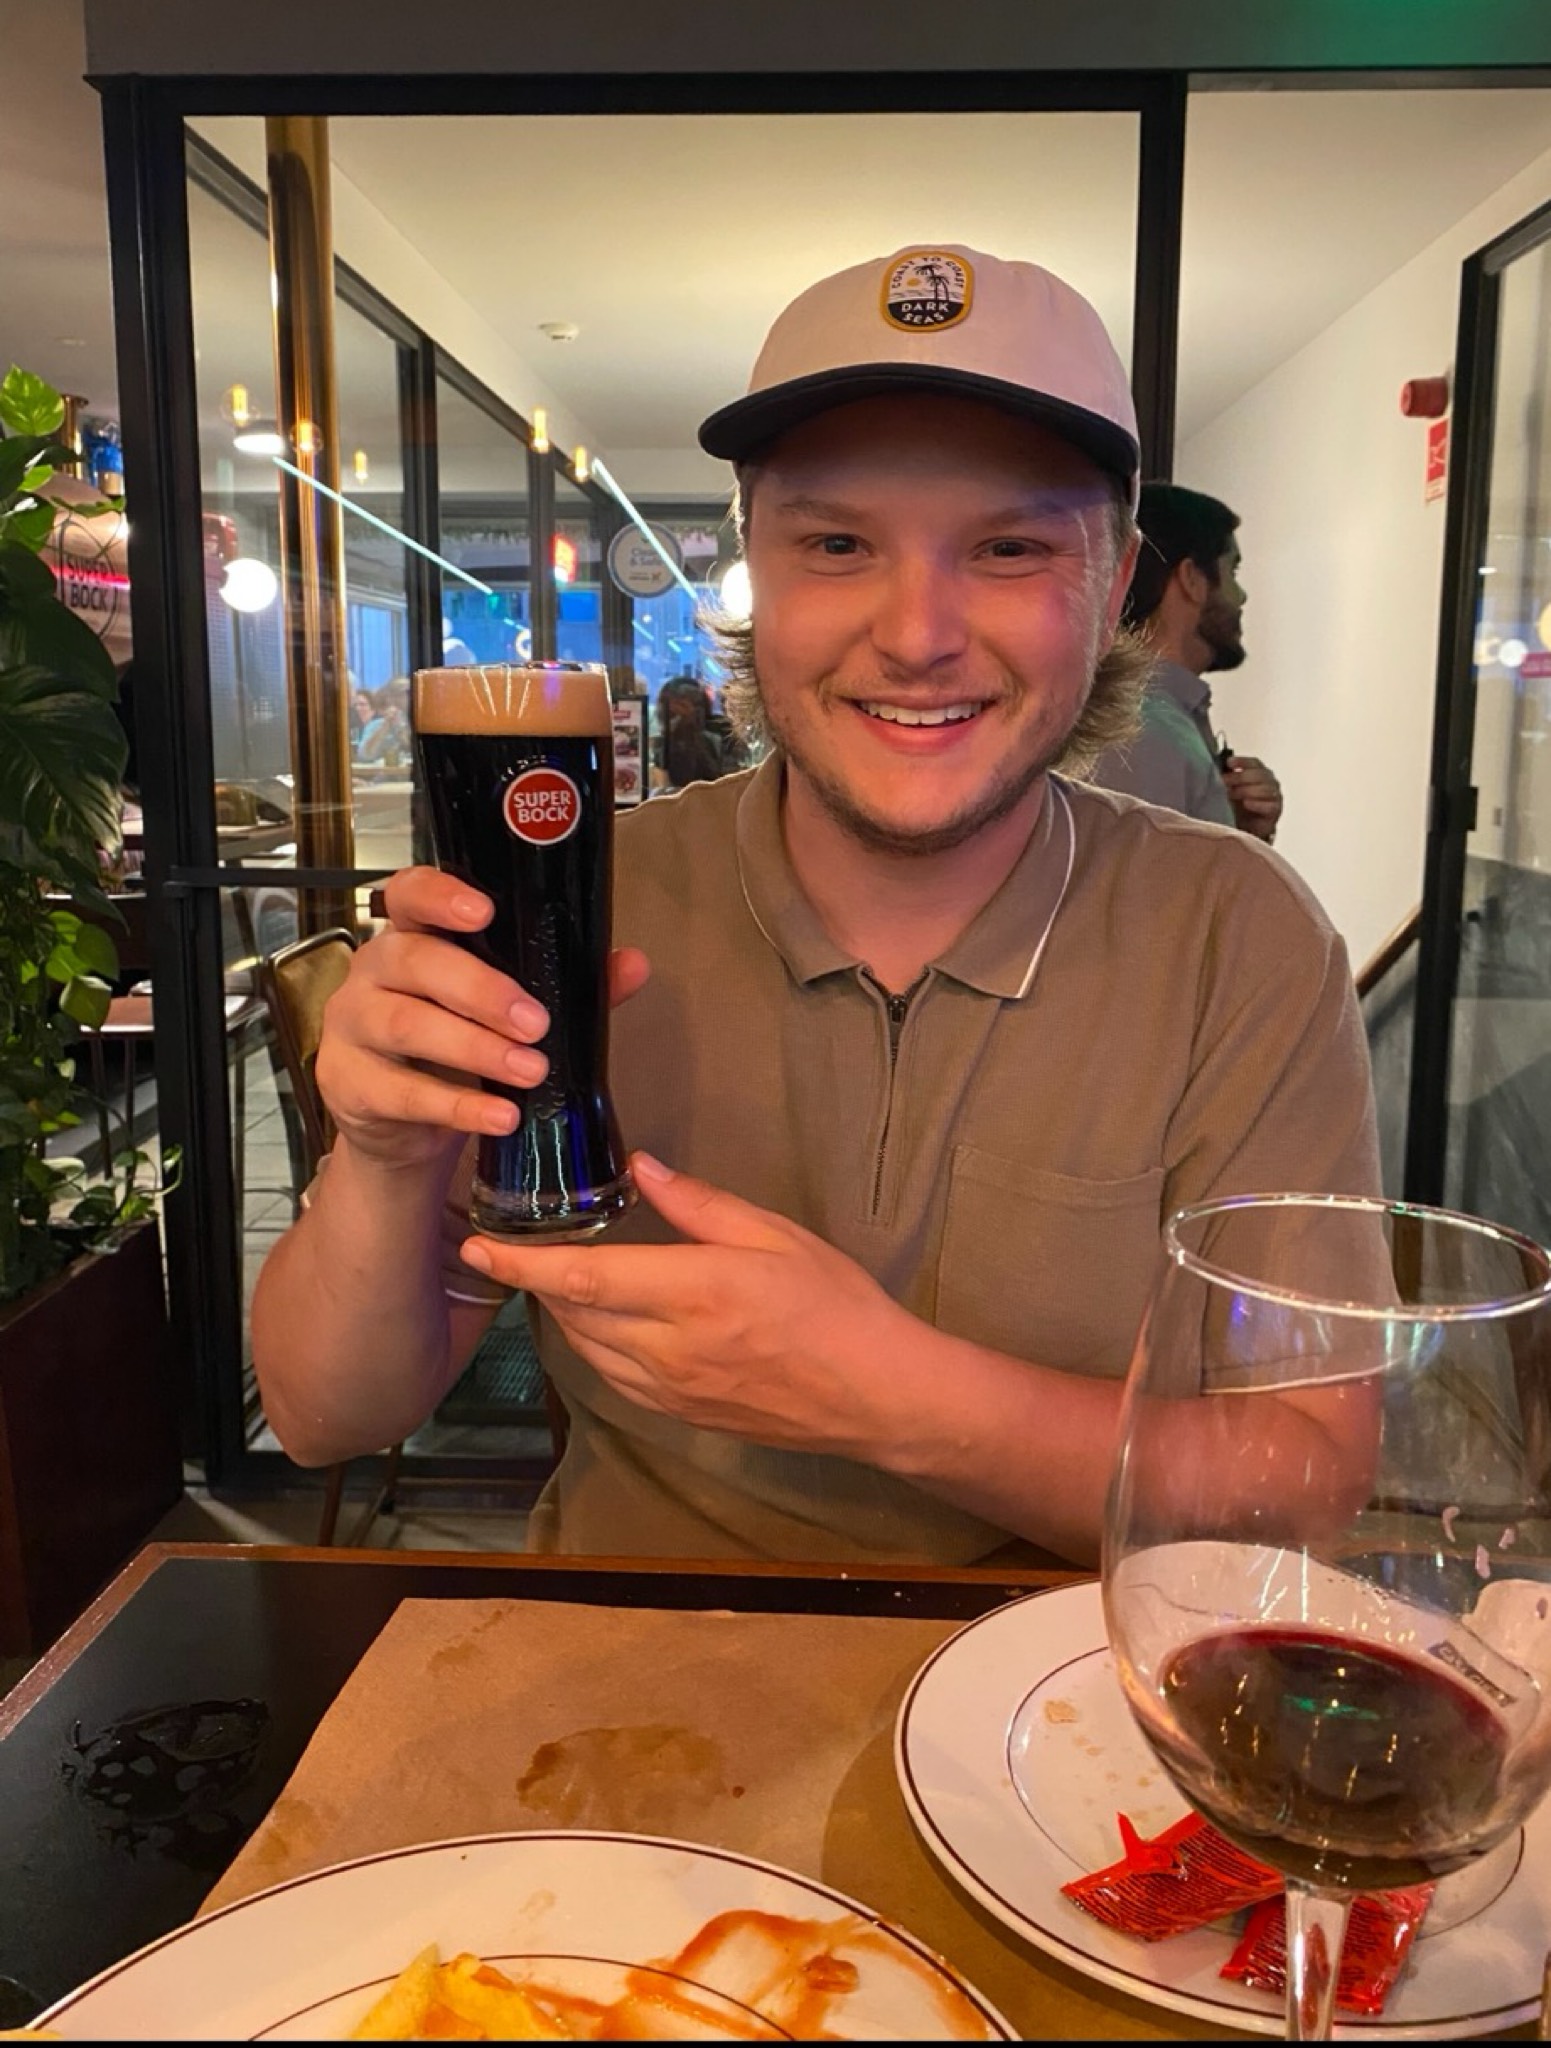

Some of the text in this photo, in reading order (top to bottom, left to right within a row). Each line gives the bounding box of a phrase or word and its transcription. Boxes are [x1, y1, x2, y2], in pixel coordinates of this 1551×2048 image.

[902, 302, 948, 312] DARK
[903, 313, 944, 324] SEAS
[68, 556, 109, 580] SUPER
[71, 583, 108, 611] BOCK
[513, 790, 571, 808] SUPER
[518, 806, 569, 823] BOCK
